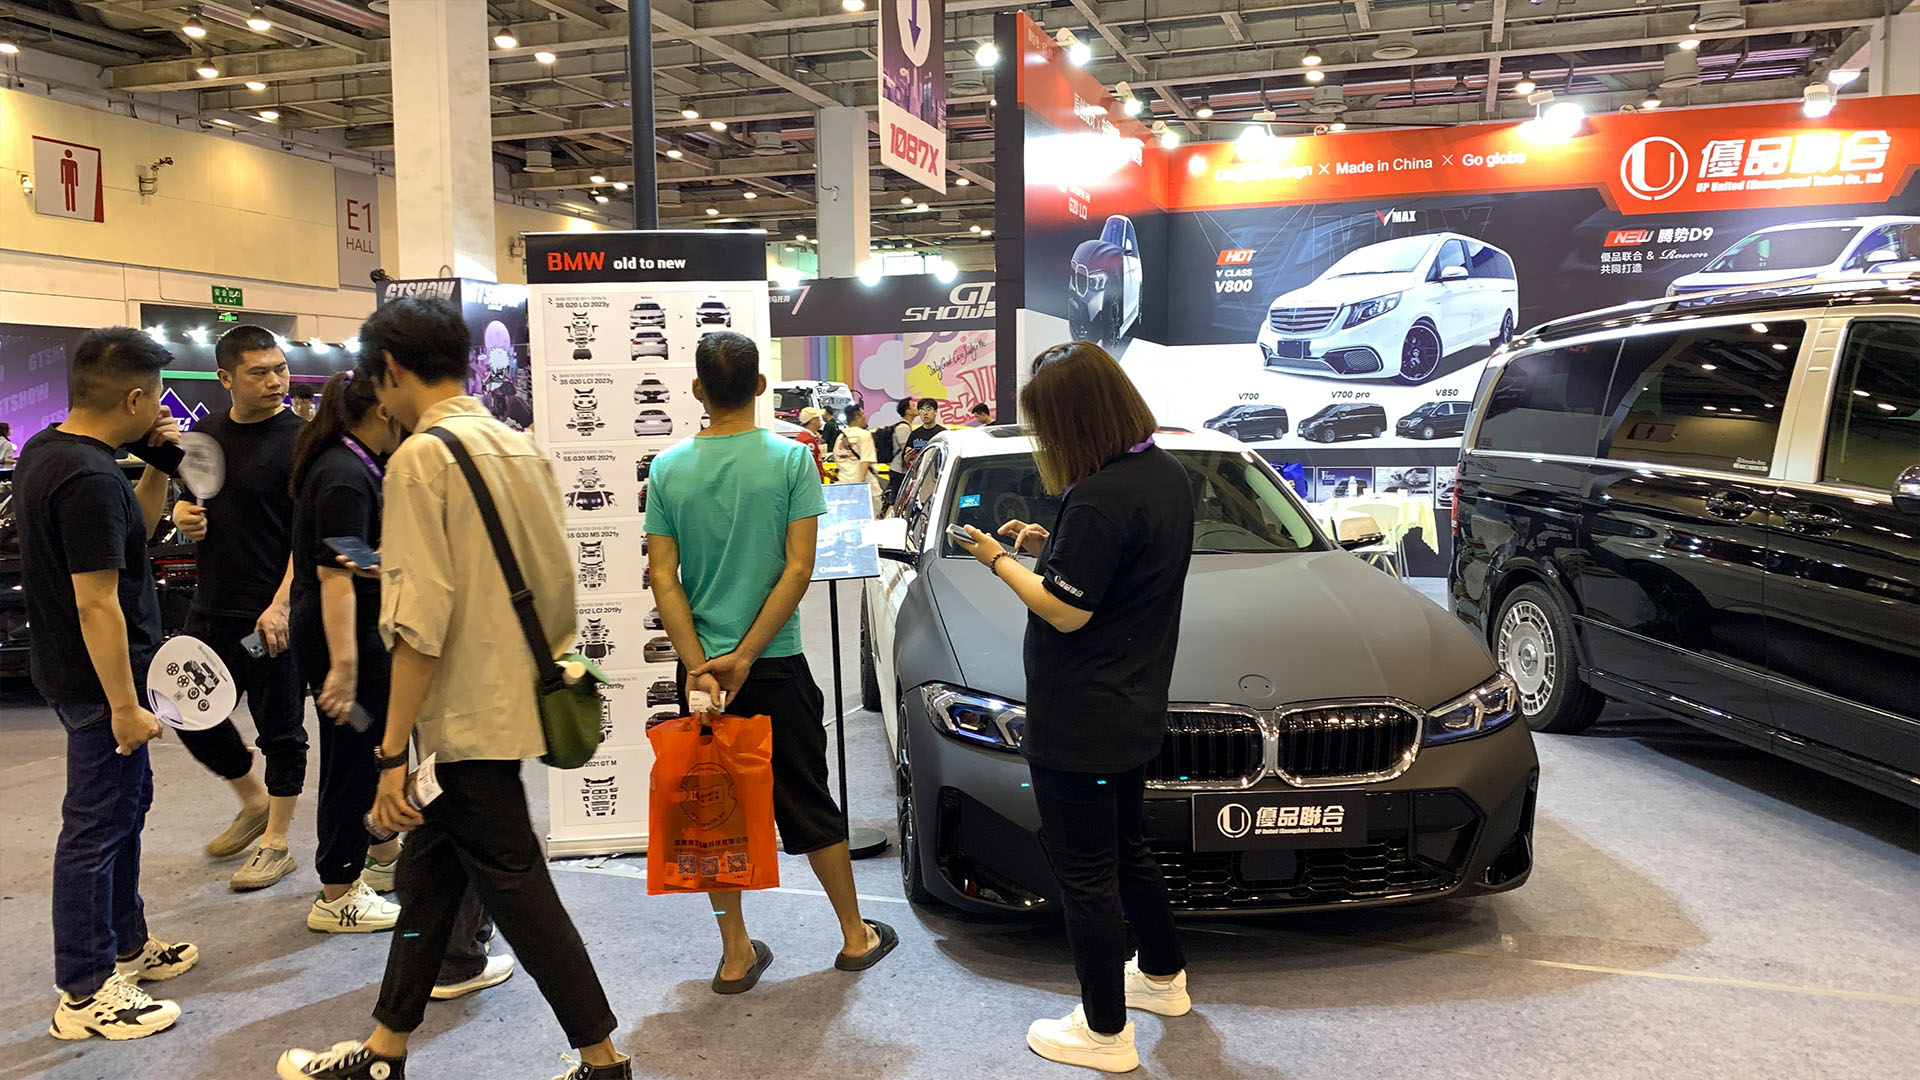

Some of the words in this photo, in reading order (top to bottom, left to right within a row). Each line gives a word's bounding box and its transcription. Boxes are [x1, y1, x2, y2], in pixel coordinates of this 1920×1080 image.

[890, 123, 939, 177] 1087X
[1336, 160, 1374, 175] Made
[1377, 159, 1389, 173] in
[1393, 156, 1433, 171] China
[1462, 153, 1484, 167] Go
[346, 199, 372, 233] E1
[1613, 230, 1655, 244] NEW
[1657, 227, 1714, 243] 腾势D9
[346, 237, 375, 254] HALL
[547, 251, 605, 272] BMW
[613, 256, 638, 270] old
[639, 257, 655, 270] to
[656, 257, 687, 270] new
[1224, 249, 1257, 263] HOT
[1646, 250, 1655, 261] &
[1216, 269, 1224, 278] V
[1224, 267, 1254, 278] CLASS
[1600, 262, 1643, 275] 共同打造
[949, 281, 997, 305] GT
[1214, 278, 1253, 294] V800
[901, 305, 986, 322] SHOW
[1238, 392, 1260, 401] V700
[1331, 390, 1353, 399] V700
[1354, 391, 1371, 400] pro
[1435, 388, 1459, 397] V850
[1255, 805, 1345, 828] 優品聯合
